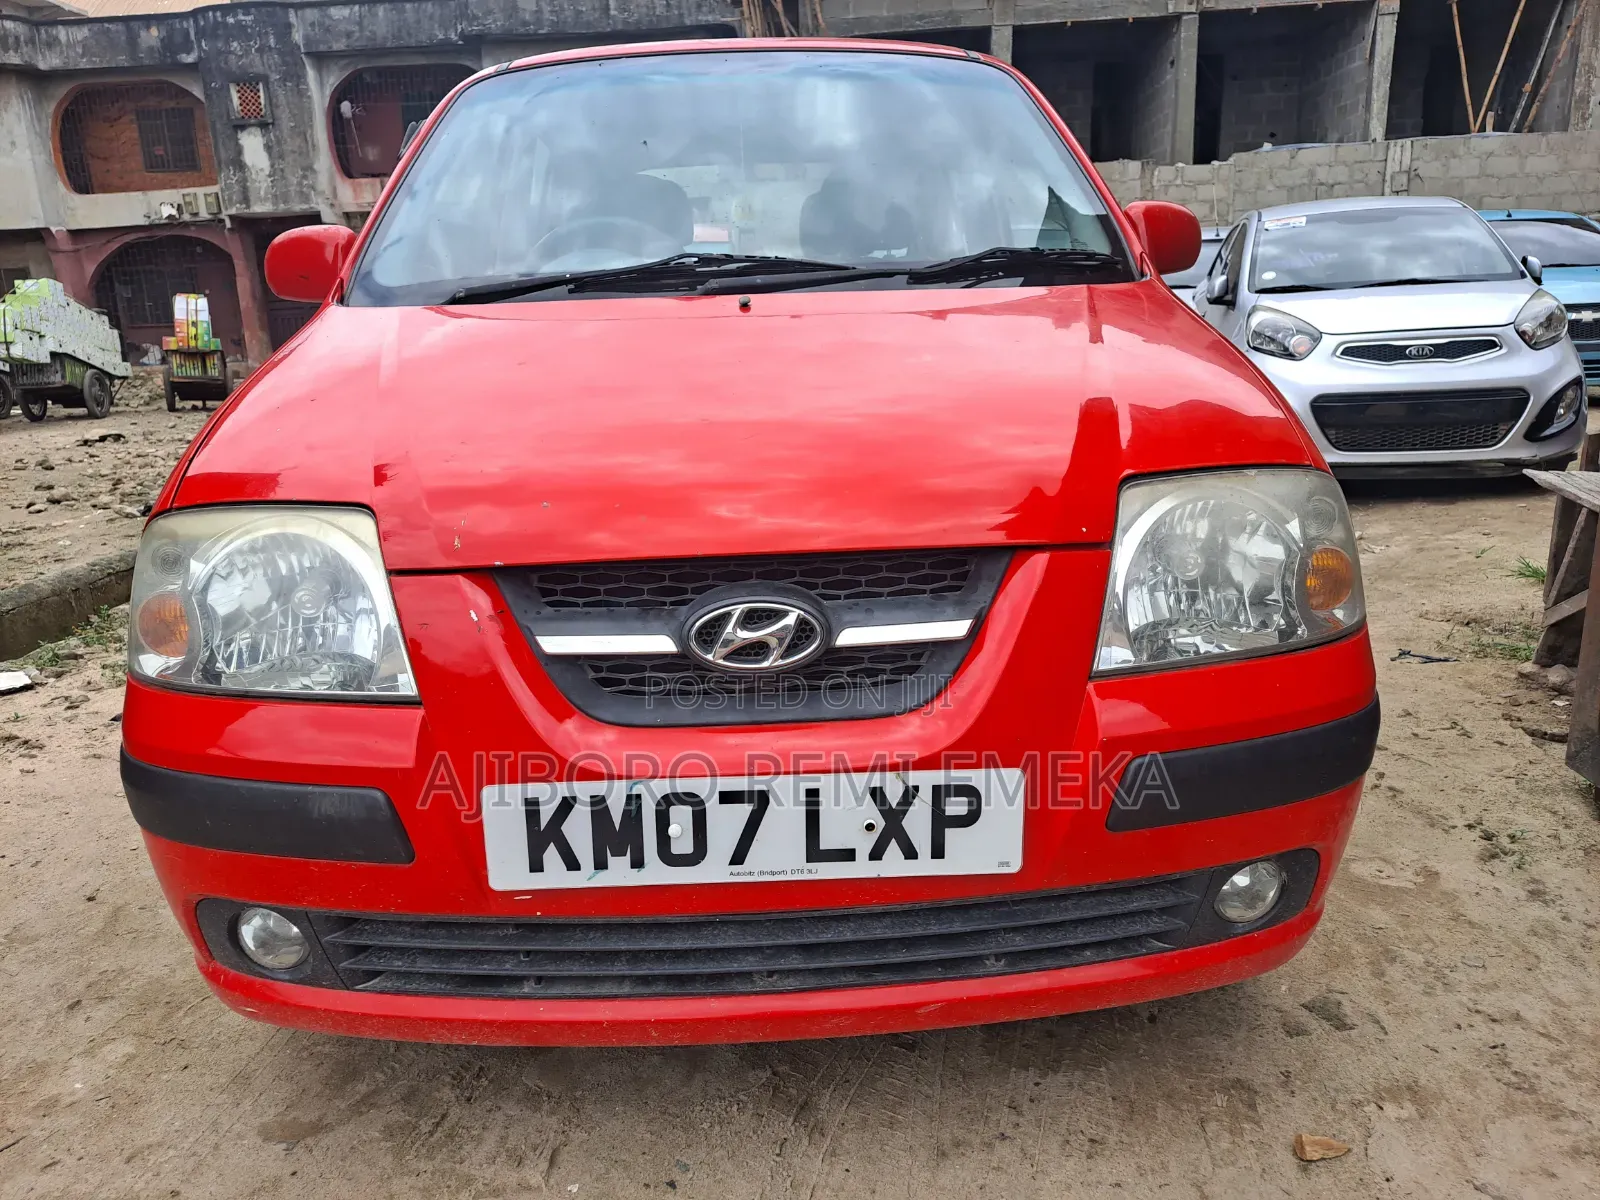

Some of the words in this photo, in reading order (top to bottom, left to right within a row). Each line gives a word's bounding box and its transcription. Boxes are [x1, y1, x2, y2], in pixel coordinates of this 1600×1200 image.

[1411, 347, 1430, 356] KIA
[524, 789, 770, 873] KM07
[804, 783, 982, 864] LXP
